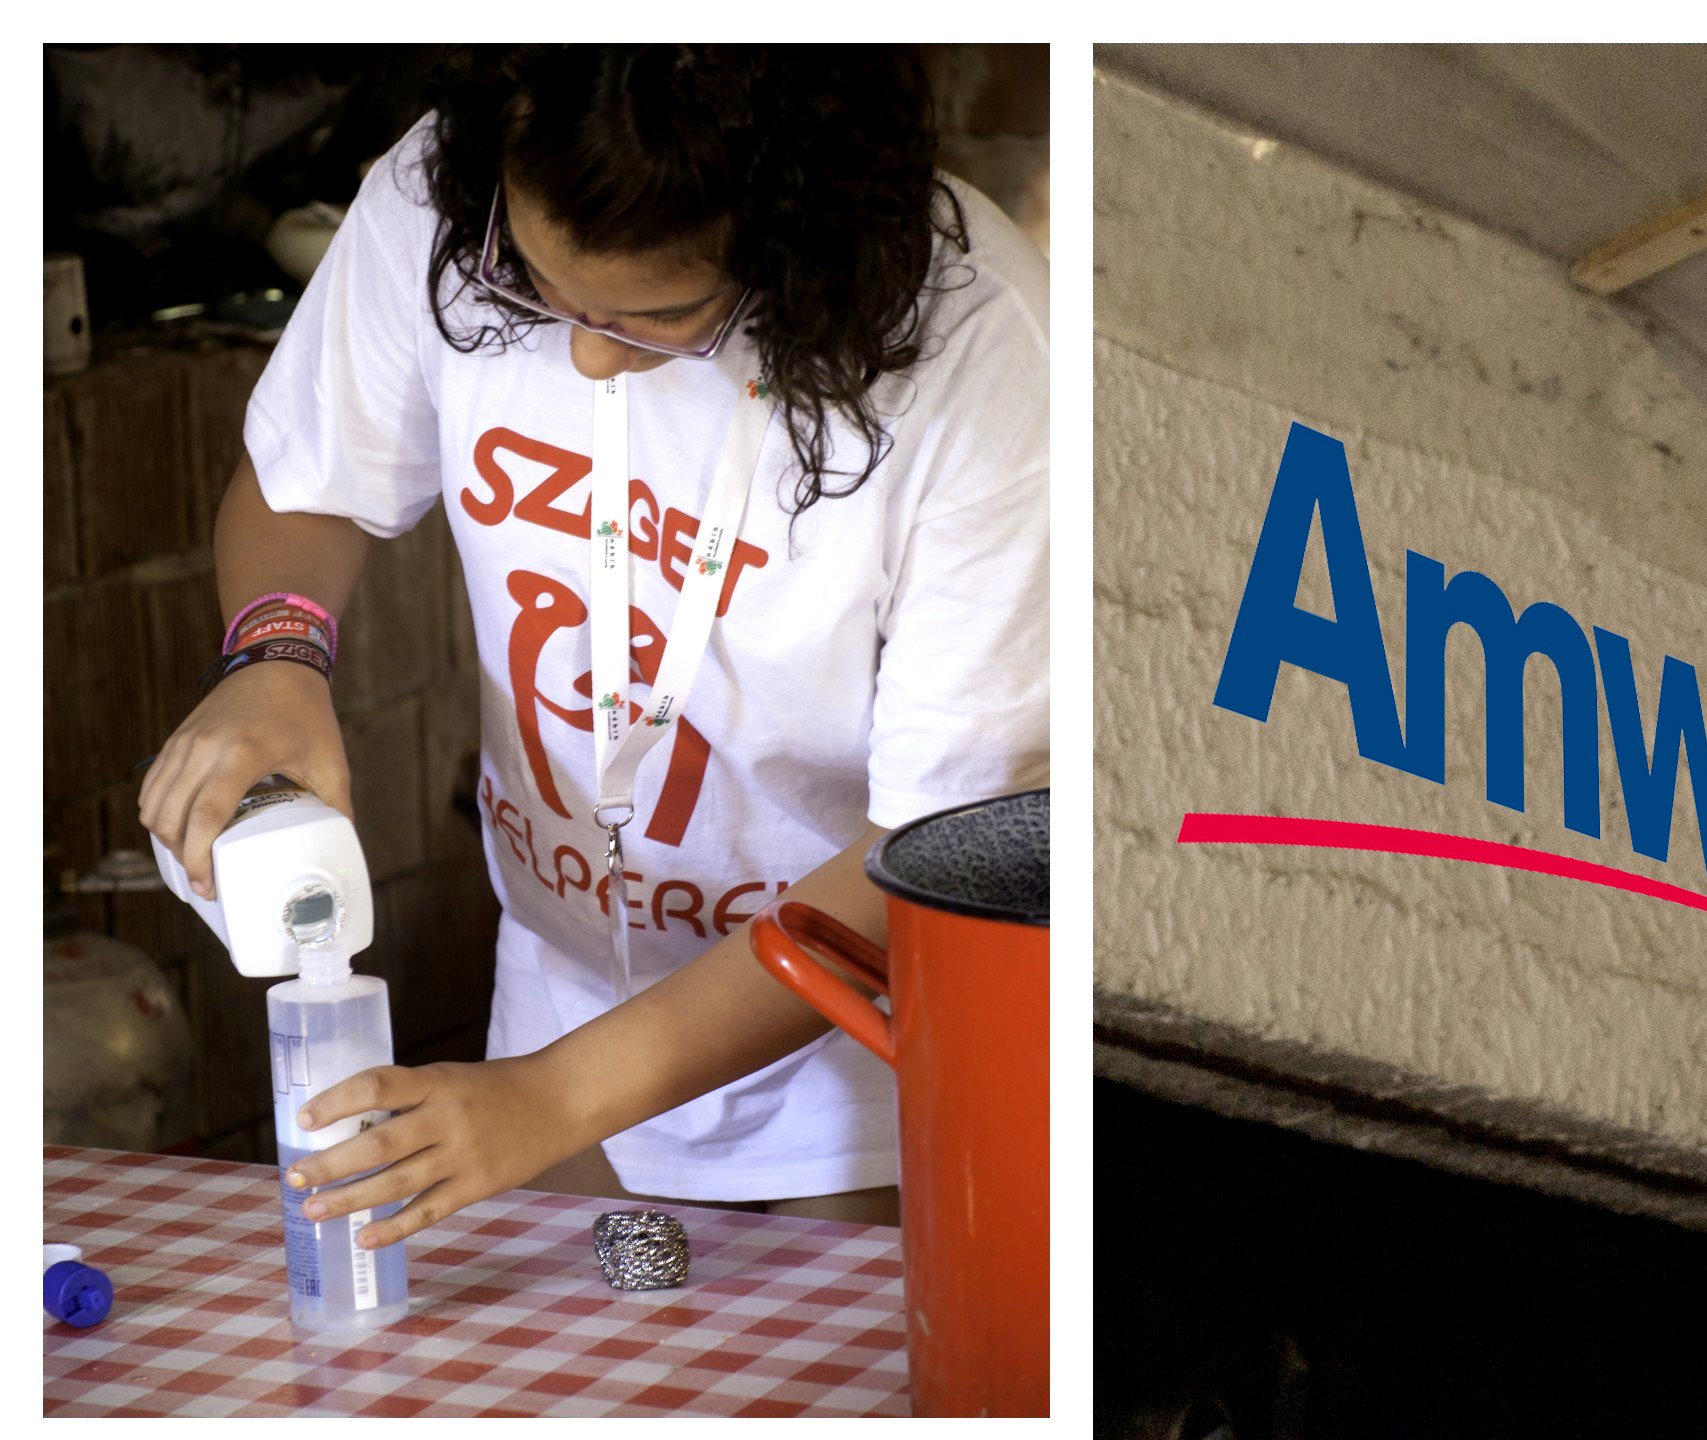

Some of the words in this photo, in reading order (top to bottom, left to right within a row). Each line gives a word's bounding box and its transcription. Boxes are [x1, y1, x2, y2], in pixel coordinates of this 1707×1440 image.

[460, 426, 770, 618] SZGET
[251, 620, 304, 638] STAFF
[240, 792, 301, 807] hom
